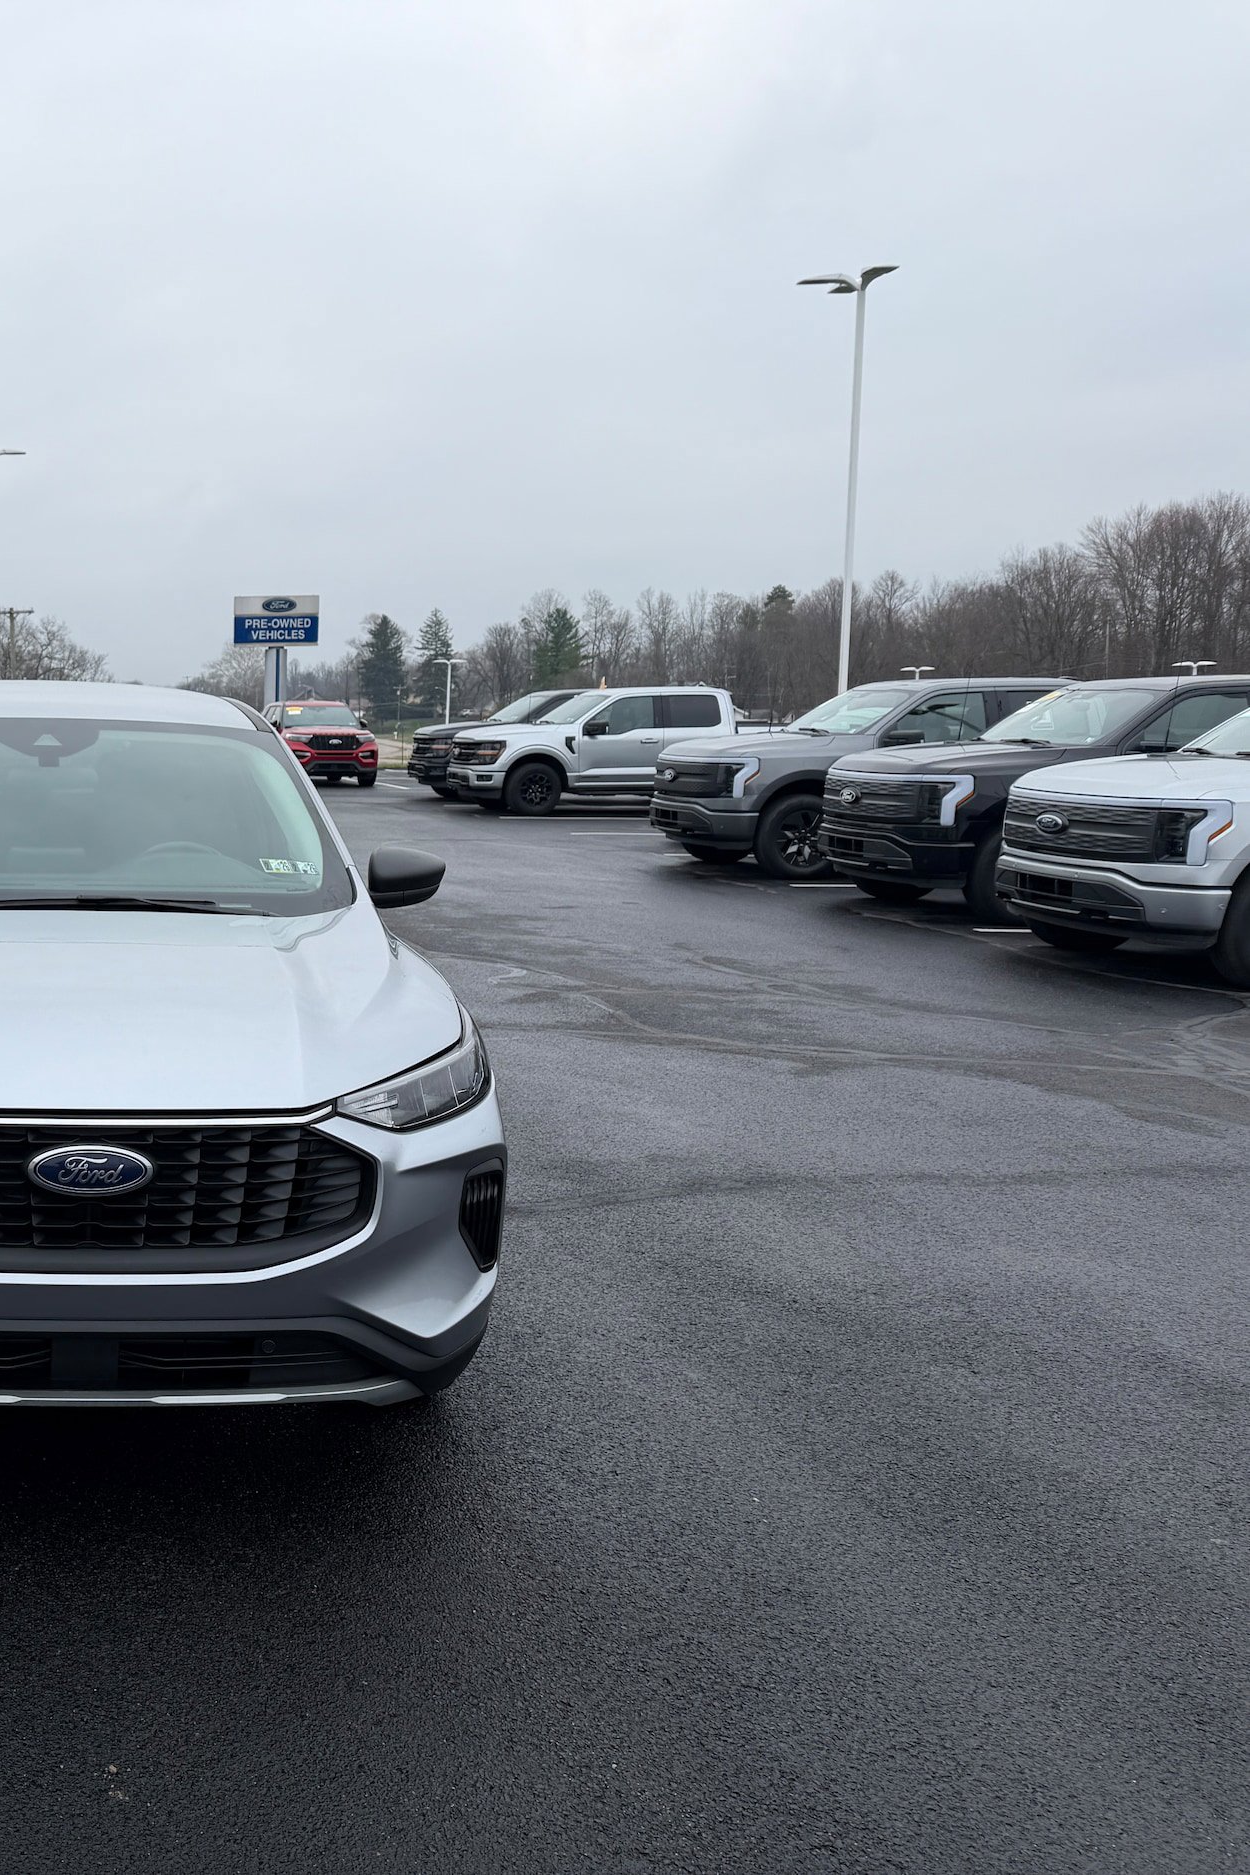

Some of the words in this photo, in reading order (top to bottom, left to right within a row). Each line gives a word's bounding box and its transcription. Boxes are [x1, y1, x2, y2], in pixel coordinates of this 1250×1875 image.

[269, 601, 289, 610] Ford
[245, 618, 311, 629] PRE-OWNED
[251, 630, 305, 640] VEHICLES
[58, 1156, 124, 1184] Ford
